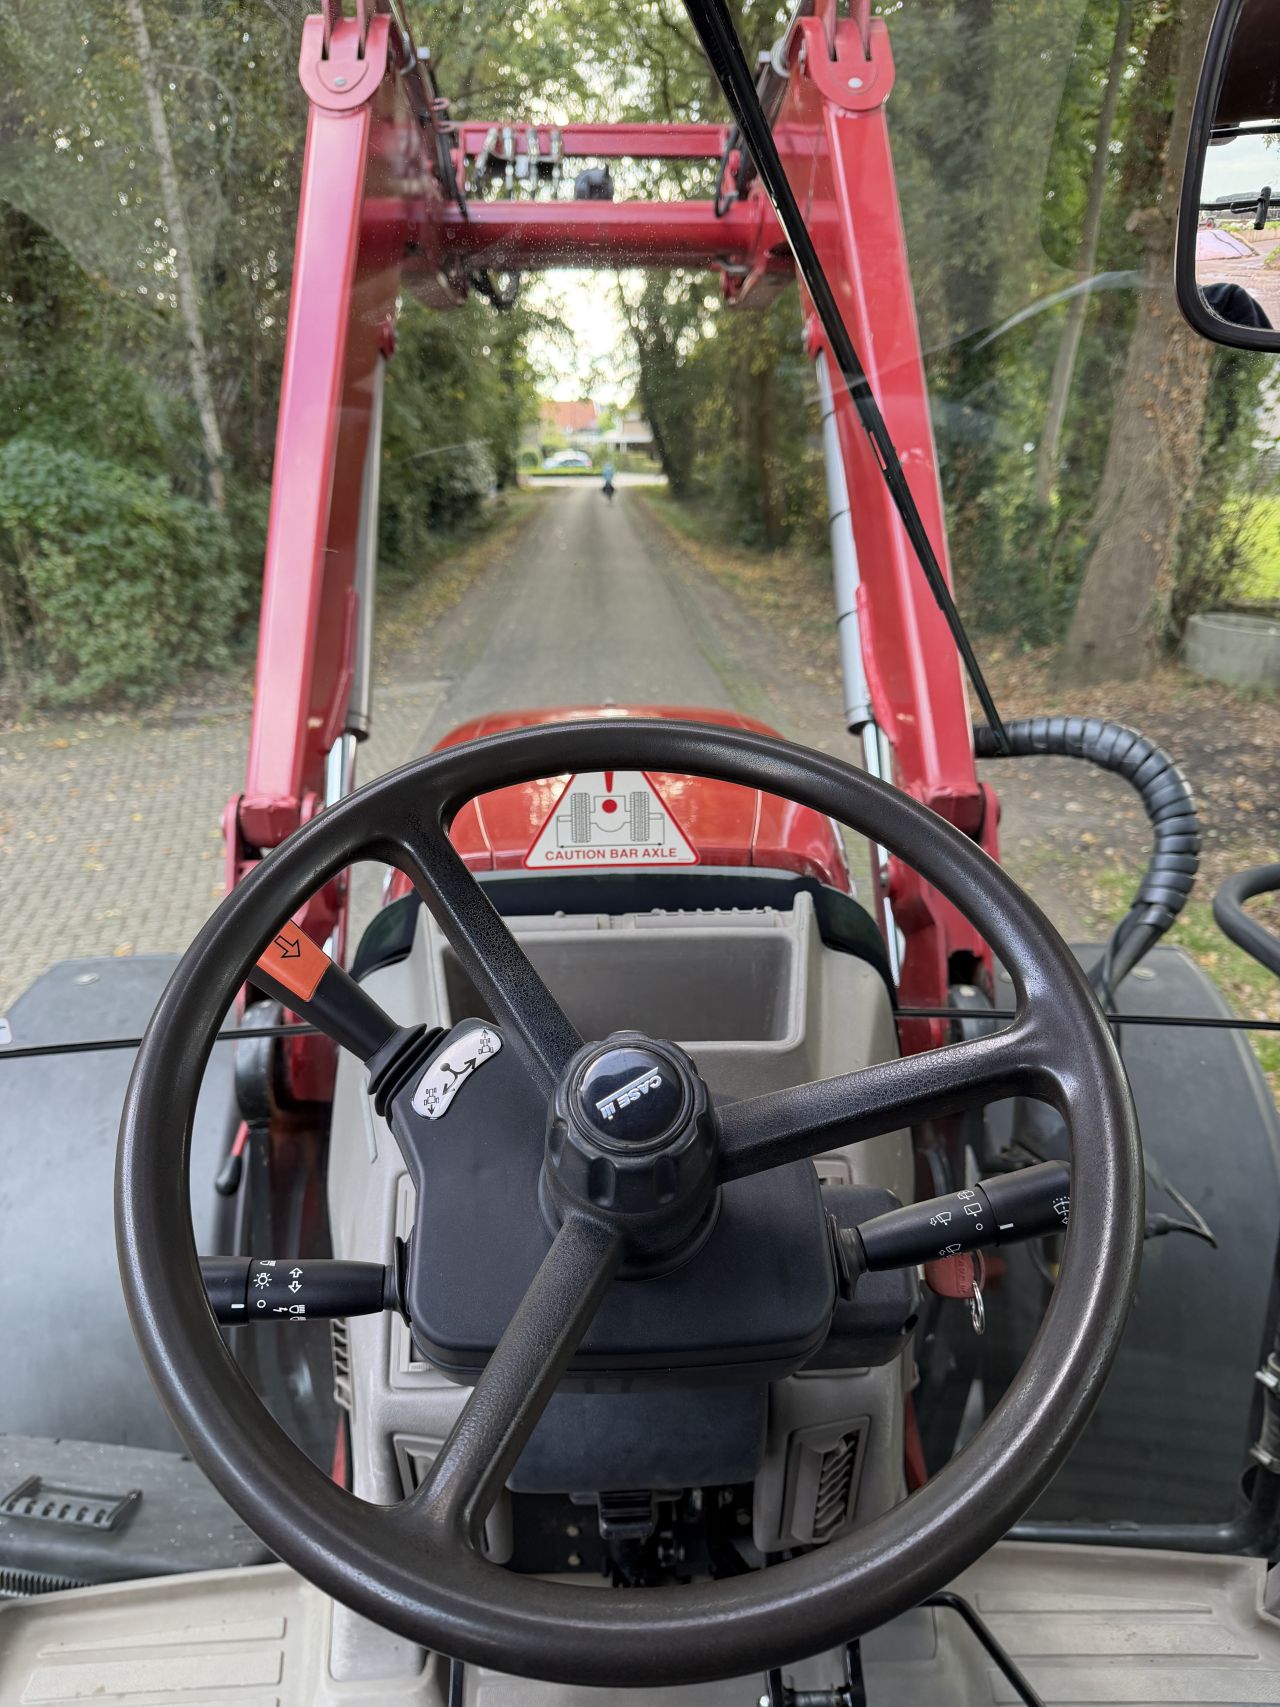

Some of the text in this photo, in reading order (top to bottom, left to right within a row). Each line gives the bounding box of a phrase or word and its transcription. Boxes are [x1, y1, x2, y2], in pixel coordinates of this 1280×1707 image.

[545, 847, 678, 861] CAUTION BAR AXLE
[617, 1075, 662, 1109] CASE
